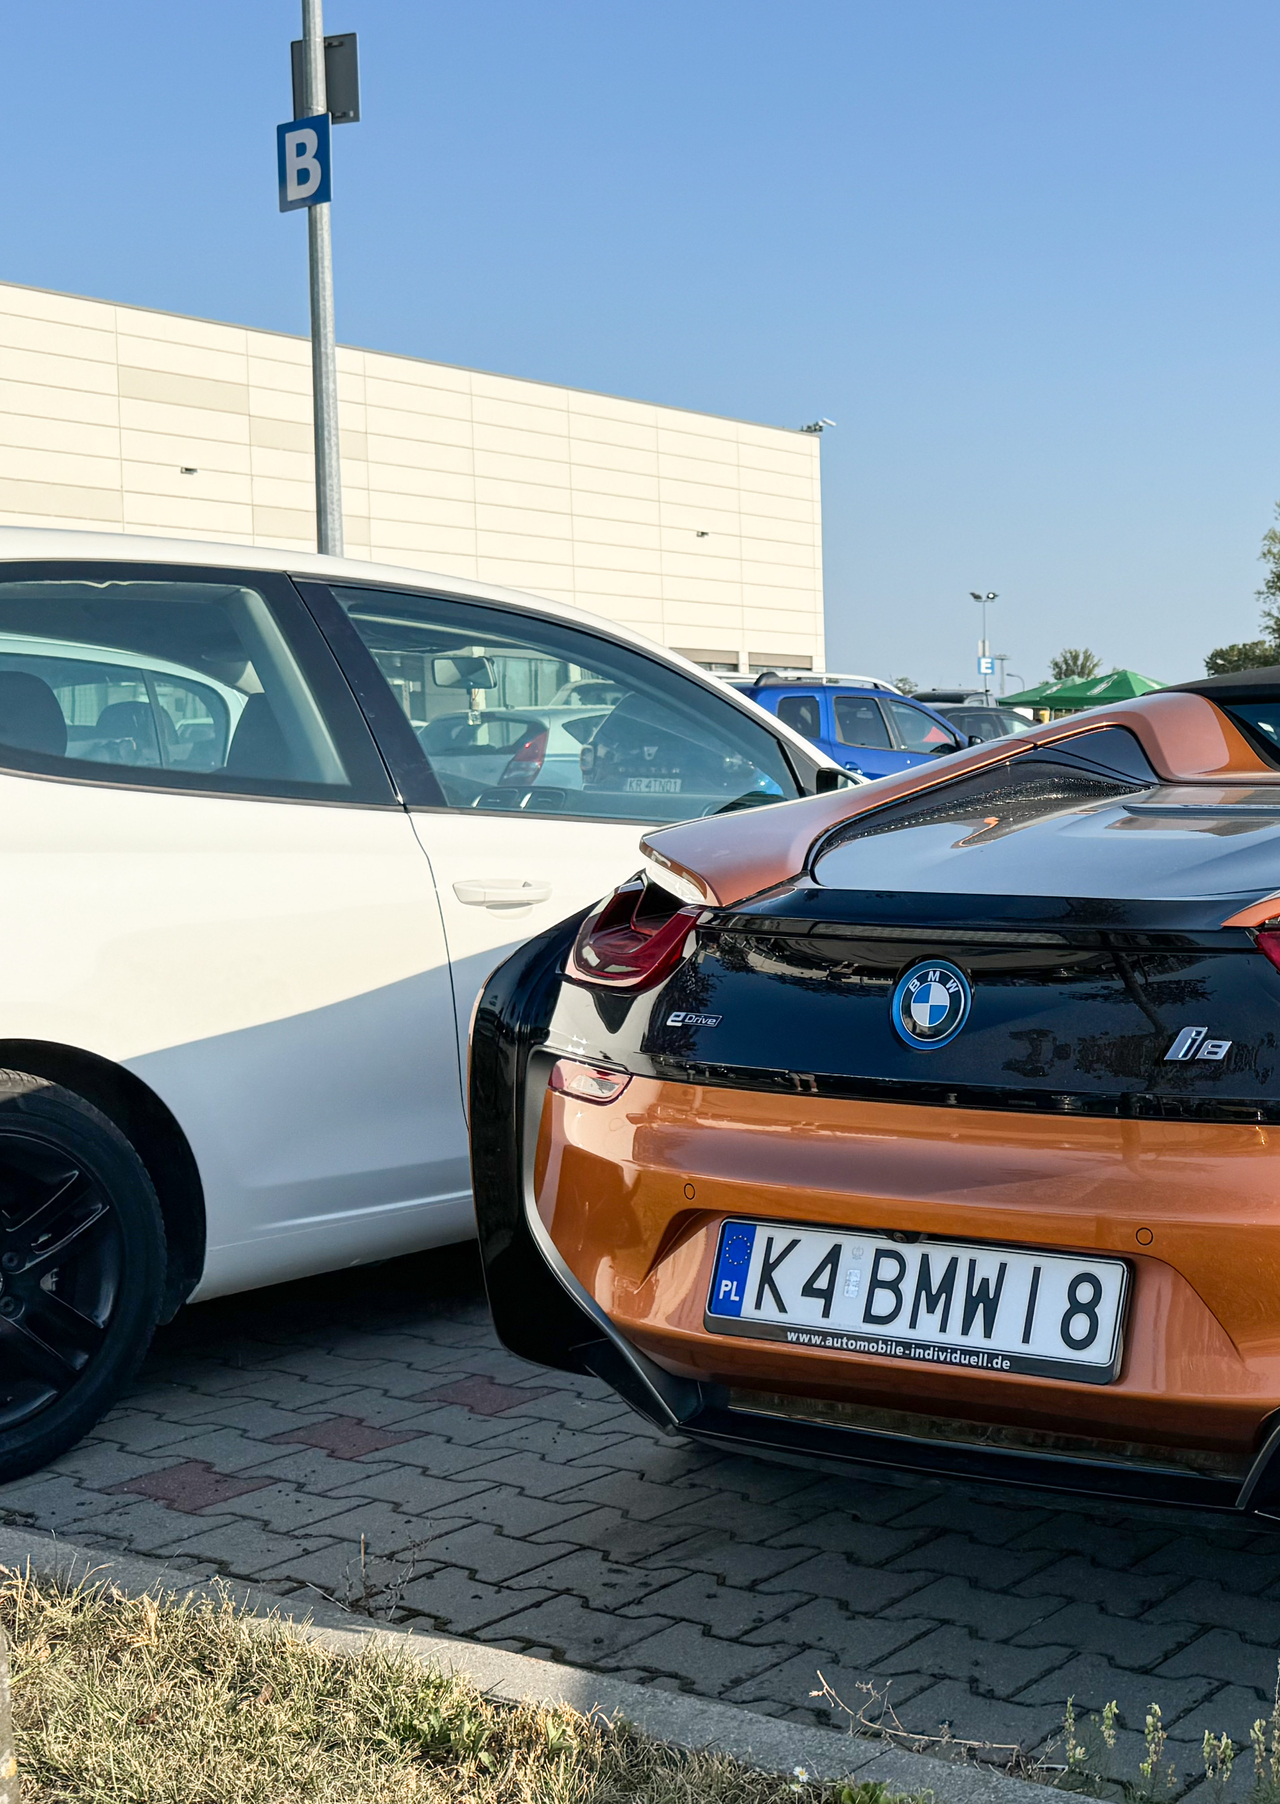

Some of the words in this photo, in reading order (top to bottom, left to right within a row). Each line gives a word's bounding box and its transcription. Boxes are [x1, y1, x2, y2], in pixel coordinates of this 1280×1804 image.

[285, 128, 322, 202] B
[981, 658, 993, 674] E
[908, 970, 960, 994] BMW
[1163, 1026, 1233, 1060] i8
[718, 1279, 741, 1303] PL
[754, 1236, 843, 1319] K4
[786, 1329, 1012, 1371] www.automobile-individuell.de
